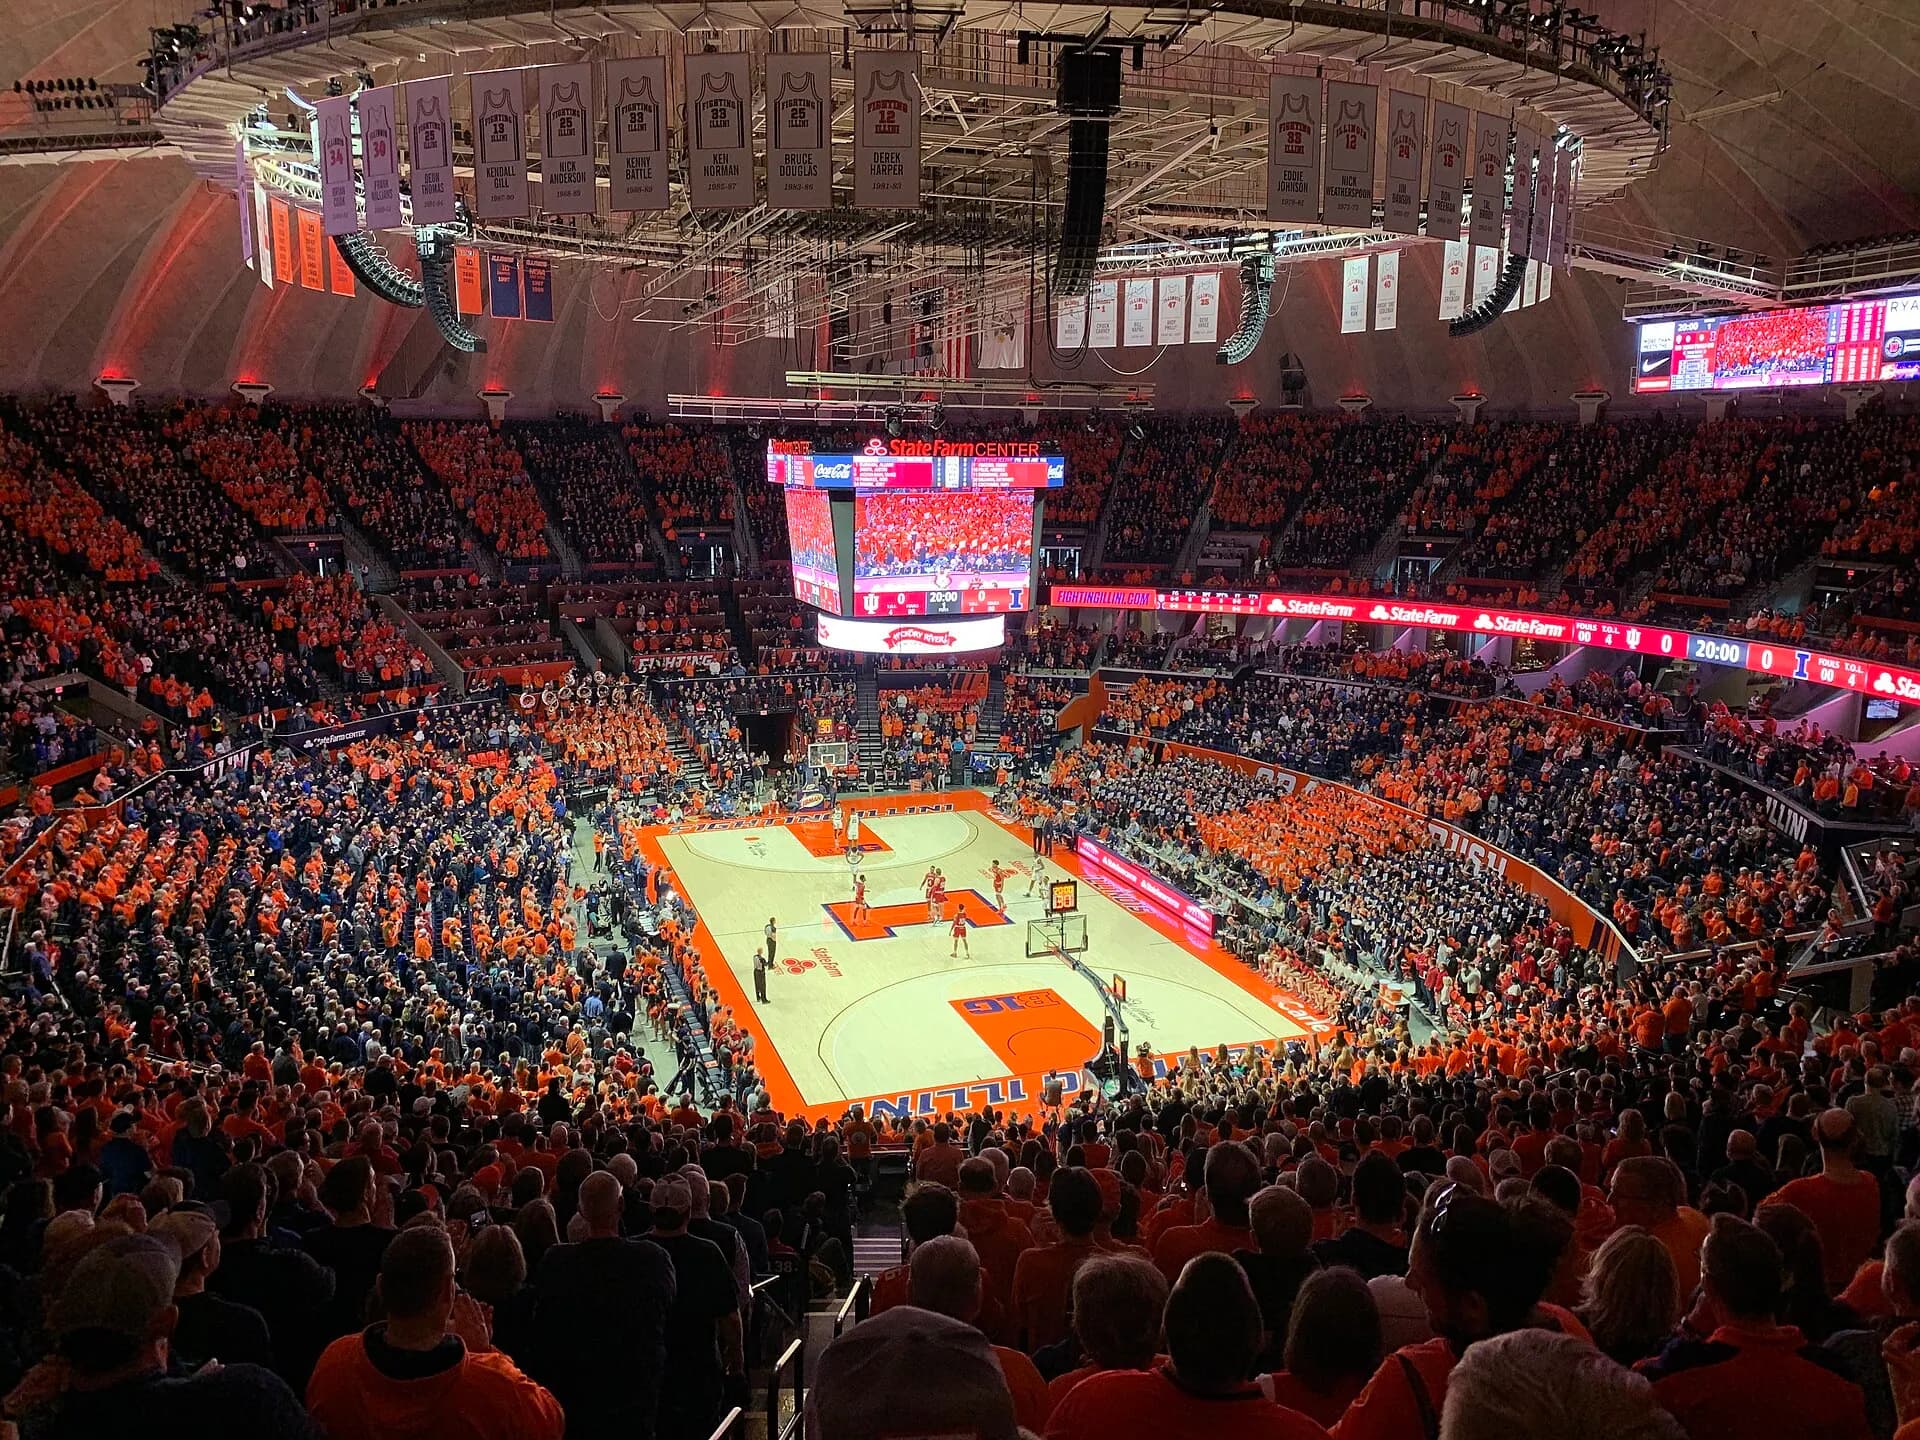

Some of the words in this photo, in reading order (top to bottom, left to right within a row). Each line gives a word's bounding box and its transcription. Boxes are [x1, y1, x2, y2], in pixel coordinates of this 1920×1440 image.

[622, 103, 652, 115] FIGHTING
[702, 99, 736, 111] FIGHTING
[781, 99, 816, 110] FIGHTING
[867, 100, 908, 113] FIGHTING
[552, 108, 580, 120] FIGHTING
[790, 108, 806, 119] 25
[879, 110, 896, 123] 12
[492, 123, 505, 134] 13
[559, 117, 573, 129] 25
[875, 124, 900, 134] ILLINI
[1345, 134, 1357, 150] 12
[330, 148, 344, 166] 34
[626, 156, 650, 168] KENNY
[713, 153, 729, 165] KEN
[784, 153, 813, 165] BRUCE
[873, 152, 901, 164] DEREK
[486, 166, 516, 178] KENDALL
[559, 161, 577, 172] NICK
[703, 165, 739, 177] NORMAN
[780, 165, 818, 177] DOUGLAS
[870, 165, 904, 176] HARPER
[549, 172, 586, 184] ANDERSON
[625, 168, 652, 180] BATTLE
[1283, 170, 1304, 182] EDDIE
[494, 178, 509, 188] GILL
[1277, 181, 1308, 193] JOHNSON
[1342, 175, 1357, 187] NICK
[421, 183, 444, 194] THOMAS
[975, 442, 1039, 457] CENTER
[898, 593, 906, 605] 0
[930, 591, 957, 602] 20:00
[978, 590, 985, 601] 0
[1057, 590, 1150, 606] FIGHTINGILLINI.COM
[1576, 622, 1597, 632] FOULS
[1578, 631, 1591, 643] 00
[1605, 634, 1612, 645] 4
[1661, 634, 1672, 653] 0
[1695, 639, 1739, 663] 20:00
[1761, 650, 1773, 669] 0
[1818, 657, 1840, 669] FOULS
[1820, 668, 1834, 682] 00
[1848, 673, 1856, 686] 4
[1054, 895, 1073, 909] 30
[1278, 1001, 1331, 1033] Carle
